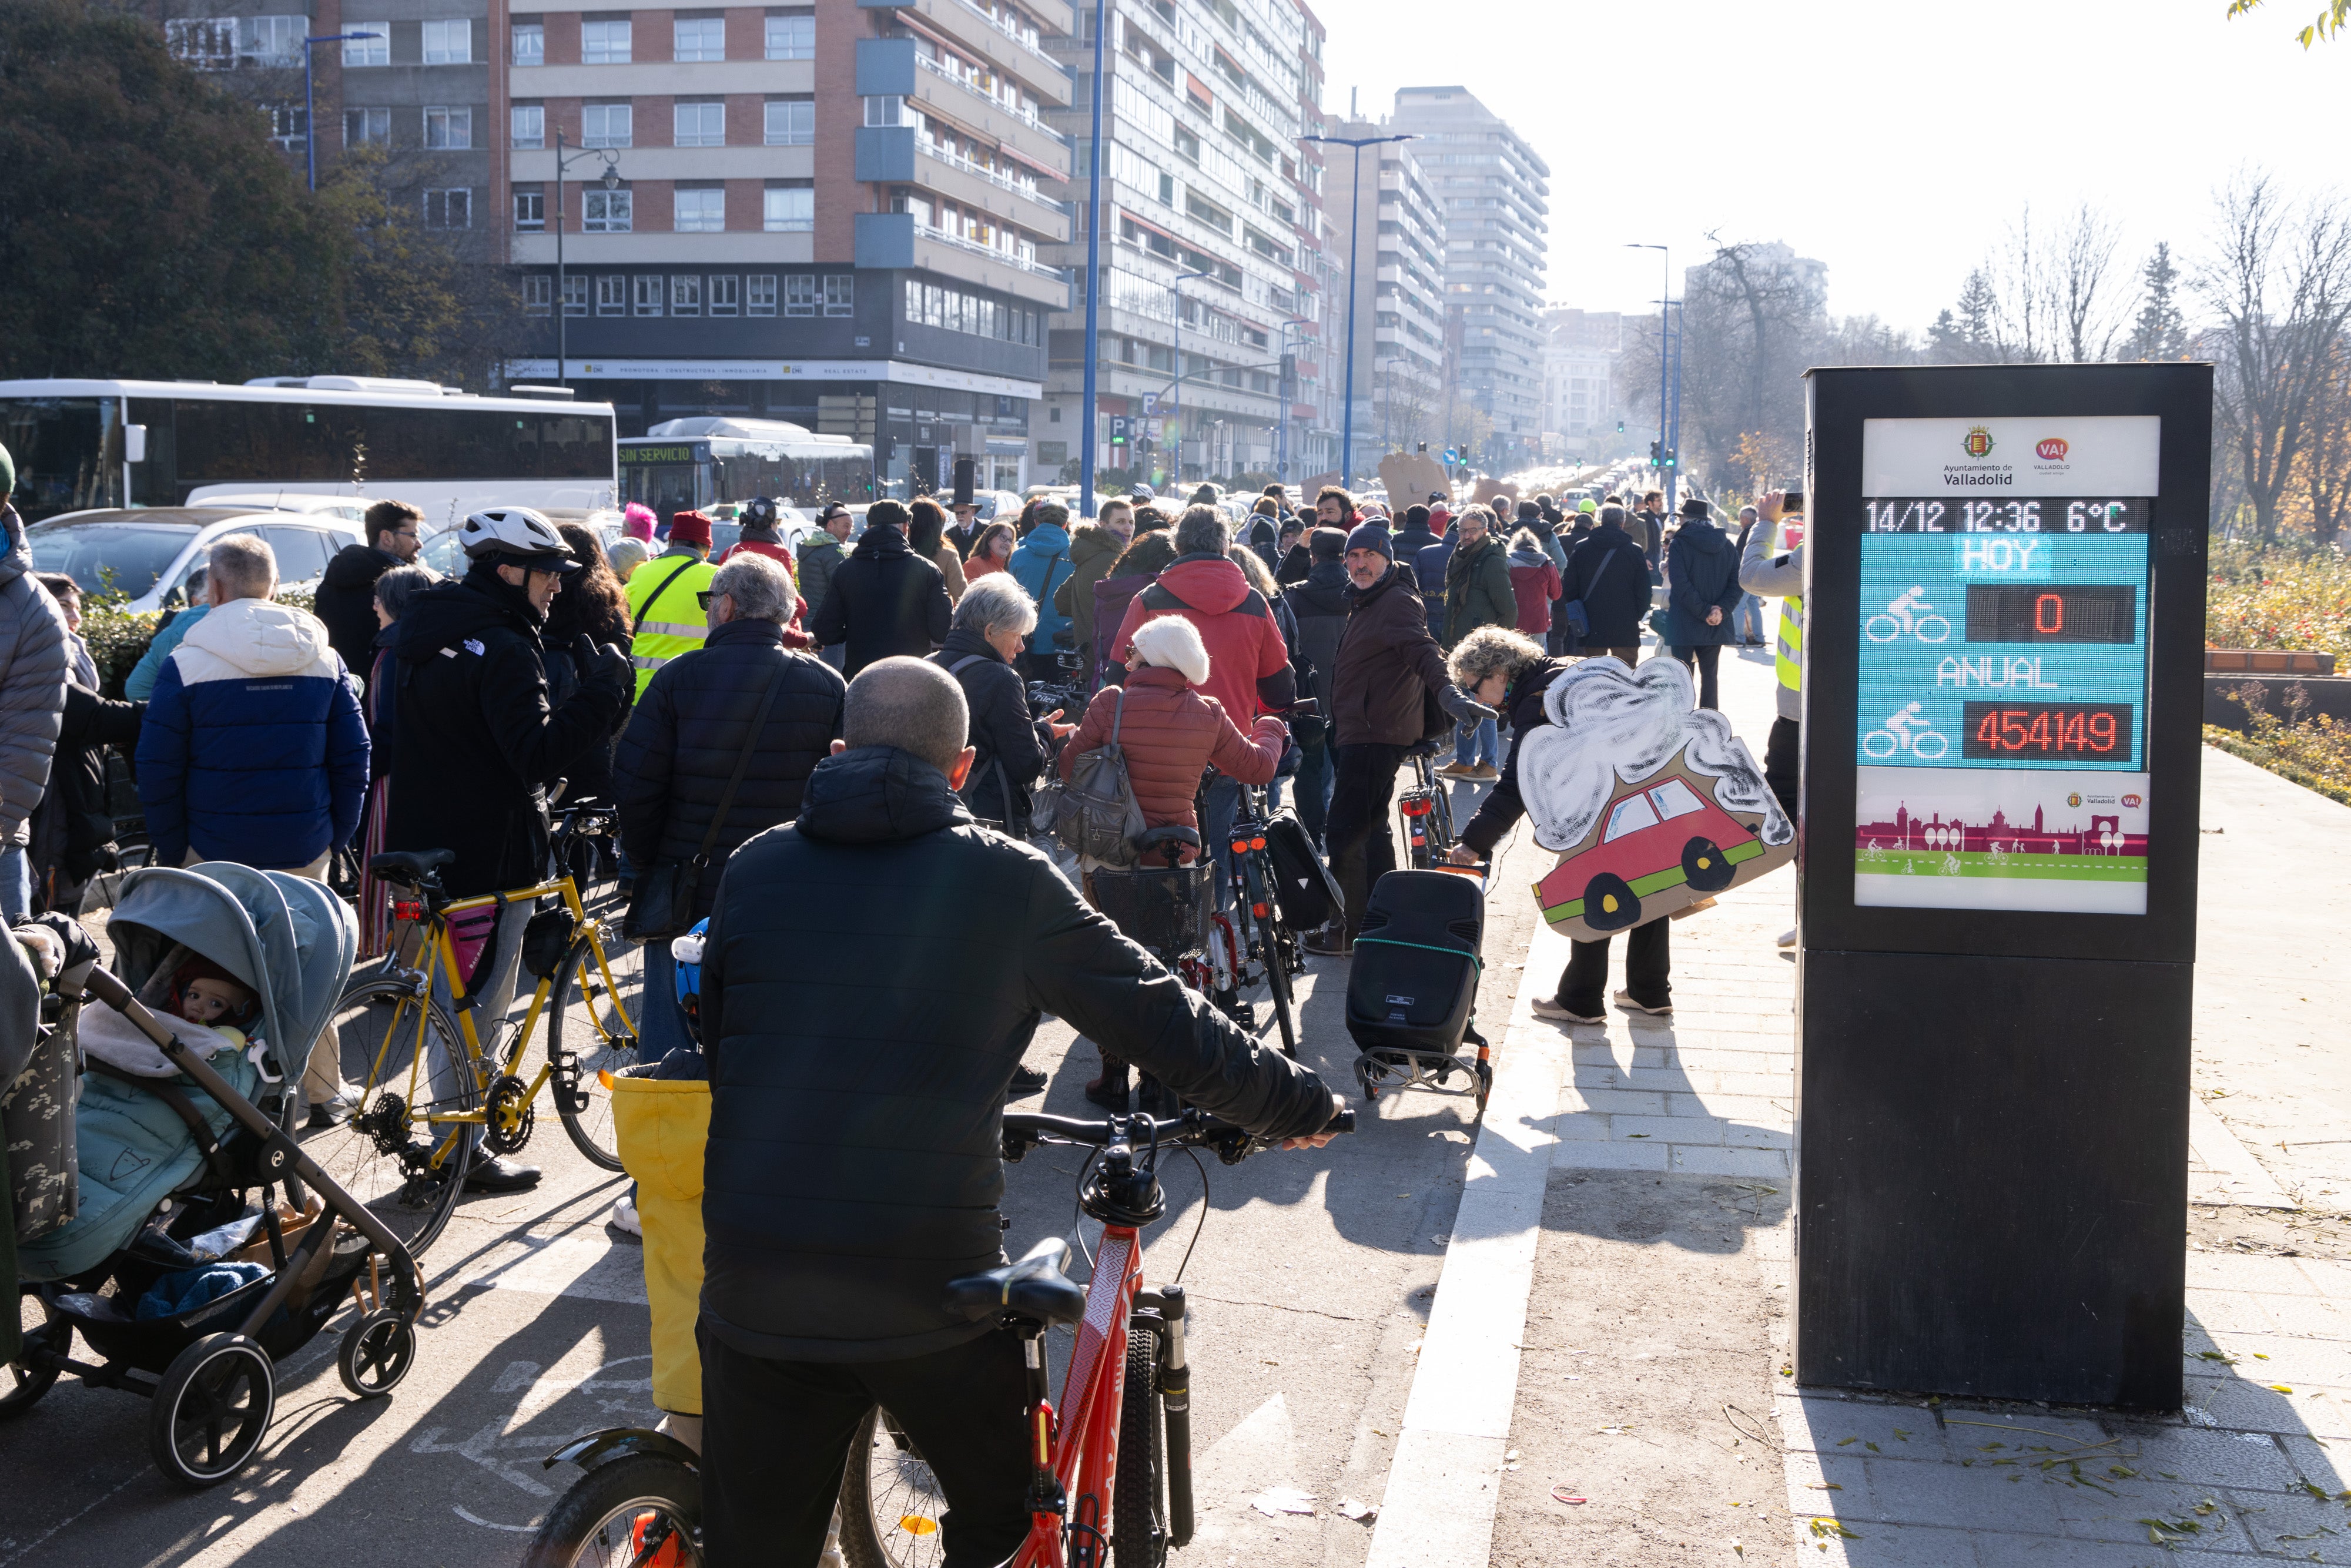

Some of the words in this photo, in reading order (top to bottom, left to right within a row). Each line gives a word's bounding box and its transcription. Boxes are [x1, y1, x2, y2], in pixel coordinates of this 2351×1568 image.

[1143, 395, 1157, 413] P
[1113, 418, 1125, 435] P
[619, 448, 637, 462] SIN
[639, 447, 689, 461] SERVICIO
[2040, 444, 2064, 455] VA!
[1944, 464, 2000, 473] Ayuntamiento
[1944, 473, 2012, 485] Valladolid
[1867, 501, 1944, 532] 14/12
[1963, 501, 2040, 532] 12:36
[1963, 538, 2038, 570] HOY
[2035, 594, 2062, 633] 0
[1937, 656, 2058, 688] ANUAL
[1034, 694, 1056, 704] Pilen
[1977, 711, 2116, 751] 454149
[2124, 797, 2139, 805] VA!
[469, 957, 478, 969] BAG
